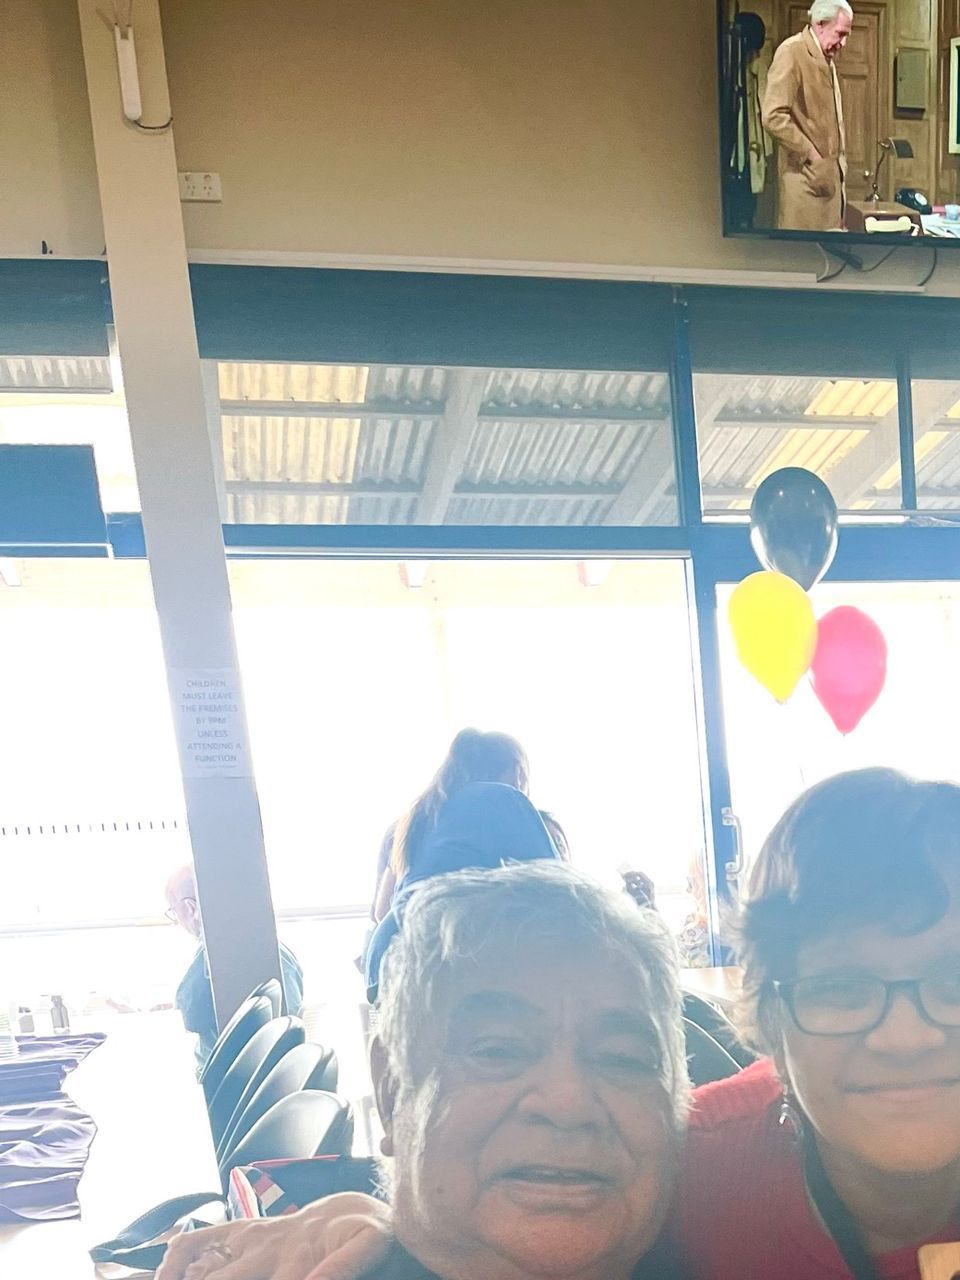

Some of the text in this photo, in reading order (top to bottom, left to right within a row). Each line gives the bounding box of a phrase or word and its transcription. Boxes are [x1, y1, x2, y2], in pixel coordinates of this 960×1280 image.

[183, 692, 206, 701] MUST
[180, 704, 198, 712] THE
[197, 730, 228, 738] UNLESS
[194, 754, 237, 762] FUNCTION
